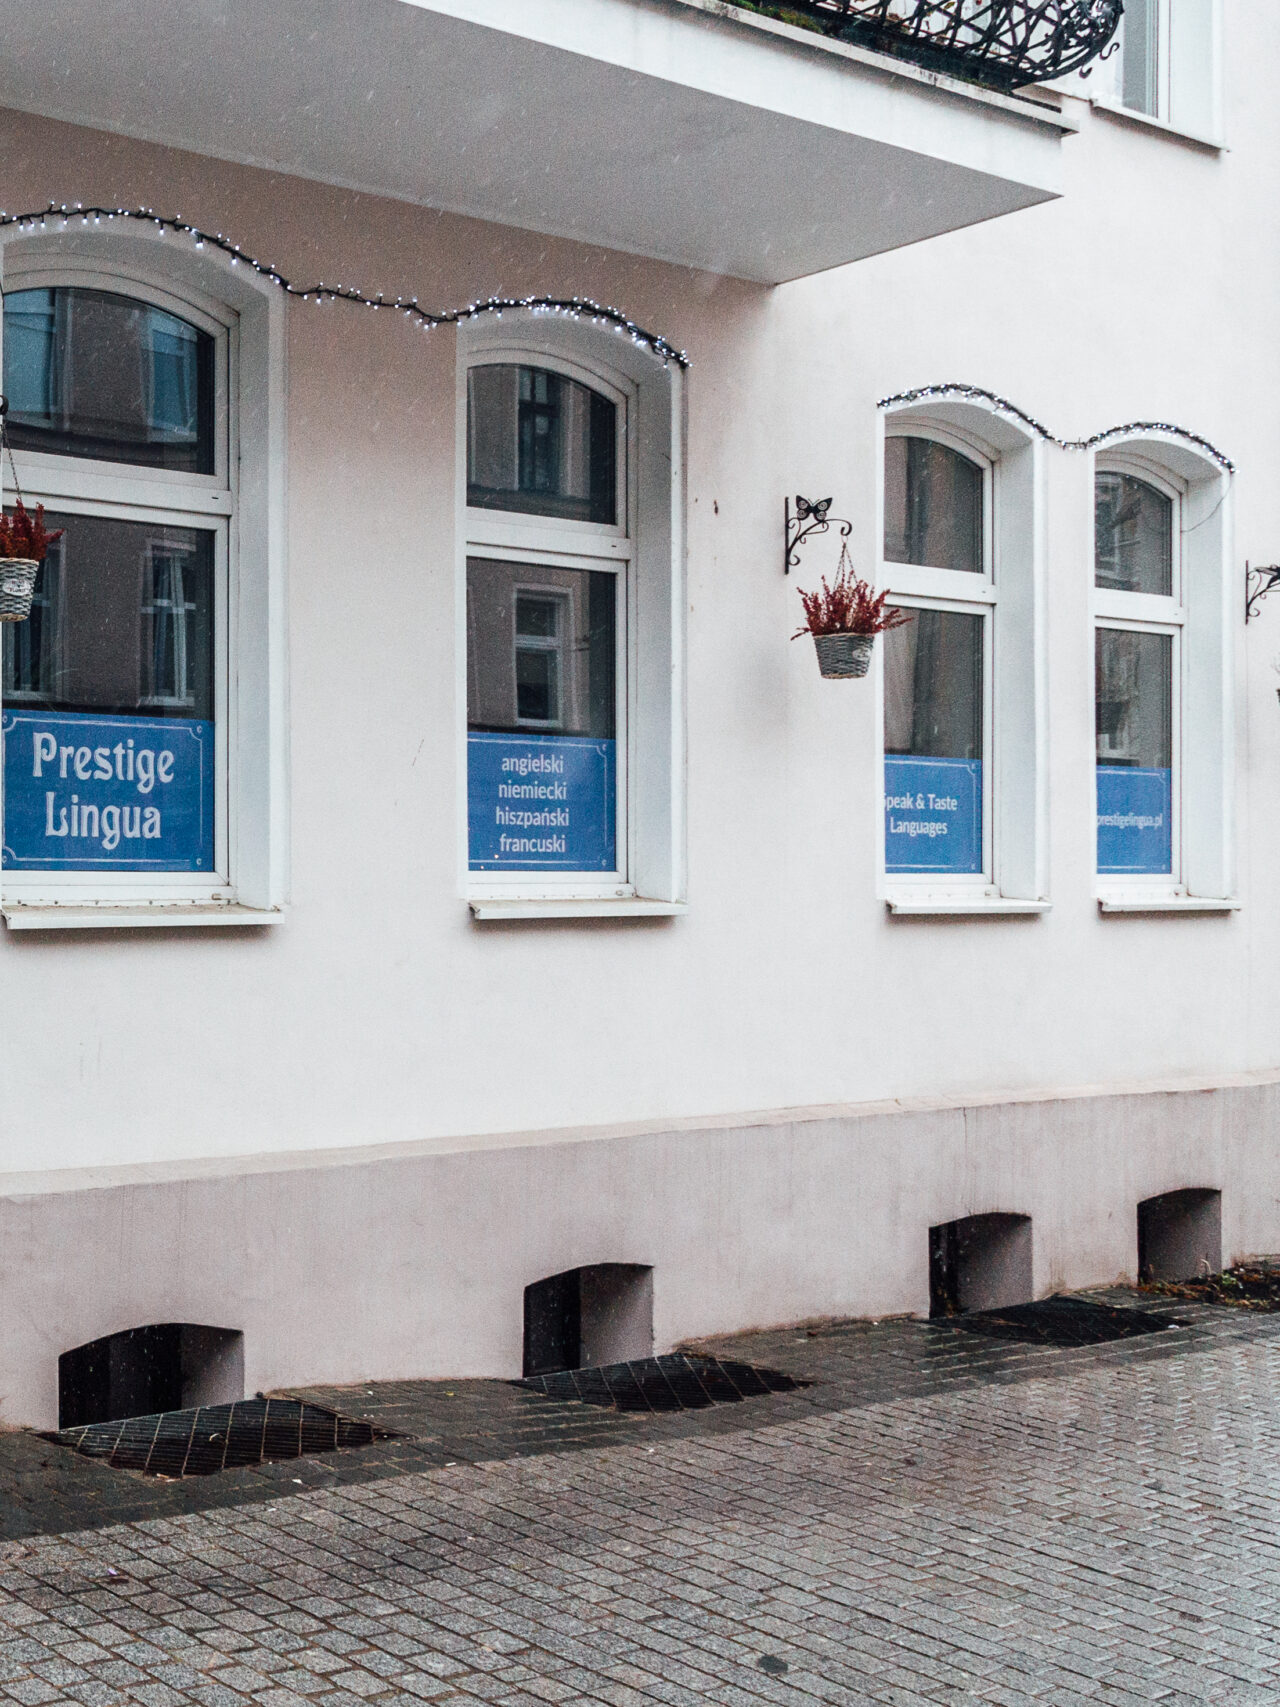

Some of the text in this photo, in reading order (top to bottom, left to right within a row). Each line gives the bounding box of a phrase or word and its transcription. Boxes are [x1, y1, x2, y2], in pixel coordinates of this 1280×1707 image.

[32, 732, 174, 793] Prestige
[501, 754, 564, 776] angielski
[498, 780, 567, 800] niemiecki
[884, 792, 958, 811] peak & Taste
[45, 791, 161, 849] Lingua
[495, 806, 569, 829] hiszpański
[890, 816, 948, 836] Languages
[499, 833, 566, 853] francuski
